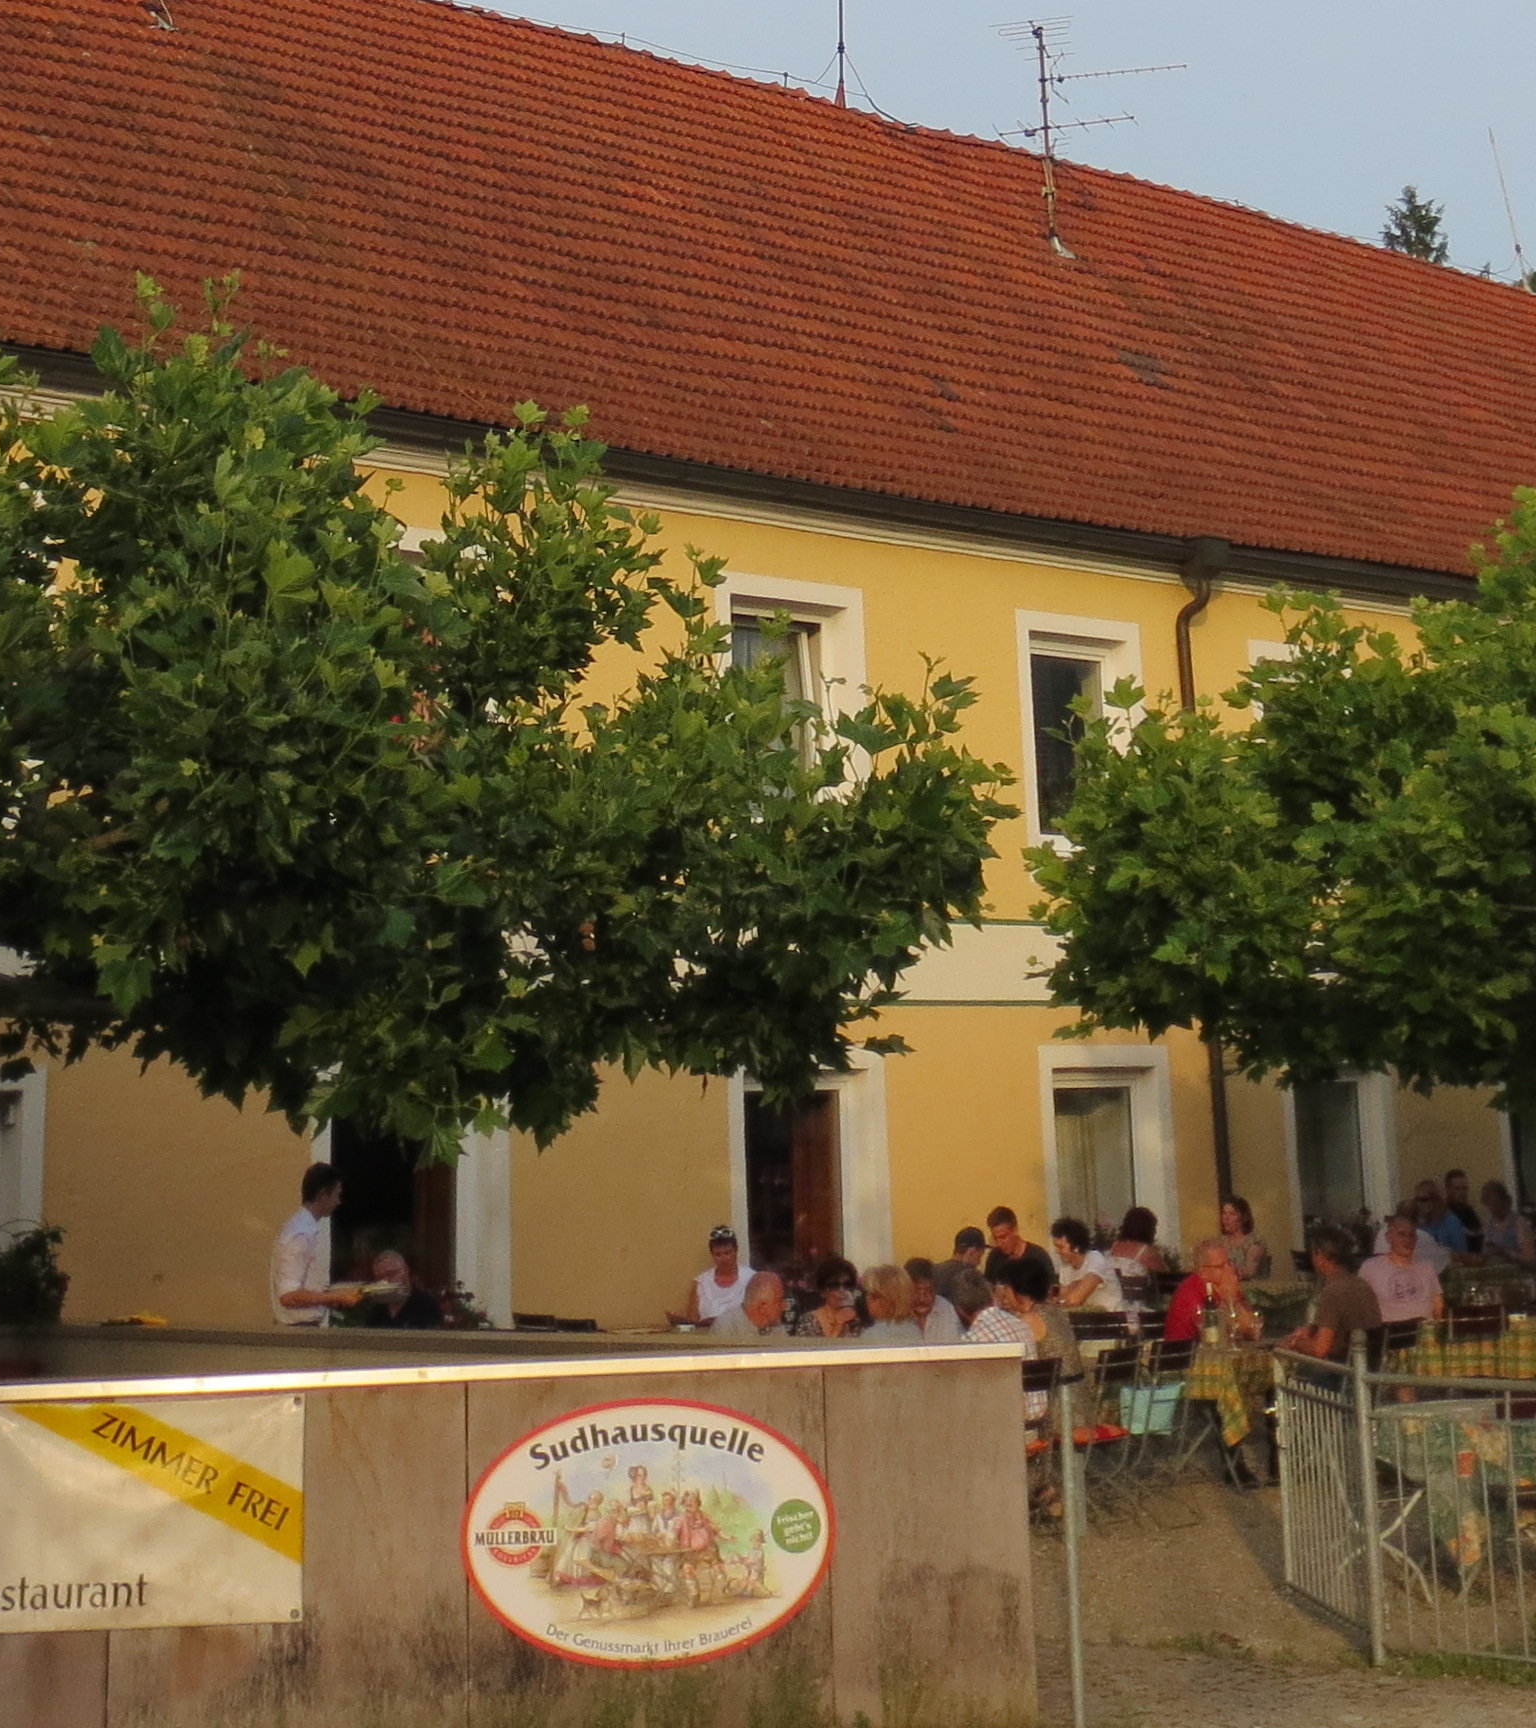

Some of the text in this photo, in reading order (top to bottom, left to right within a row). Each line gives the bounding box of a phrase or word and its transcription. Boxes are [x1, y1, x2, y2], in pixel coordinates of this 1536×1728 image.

[528, 1422, 766, 1471] Sudhausquelle
[91, 1411, 290, 1532] ZIMMER FREI
[546, 1616, 754, 1656] Der Genussmarkt Ihrer Brauerei
